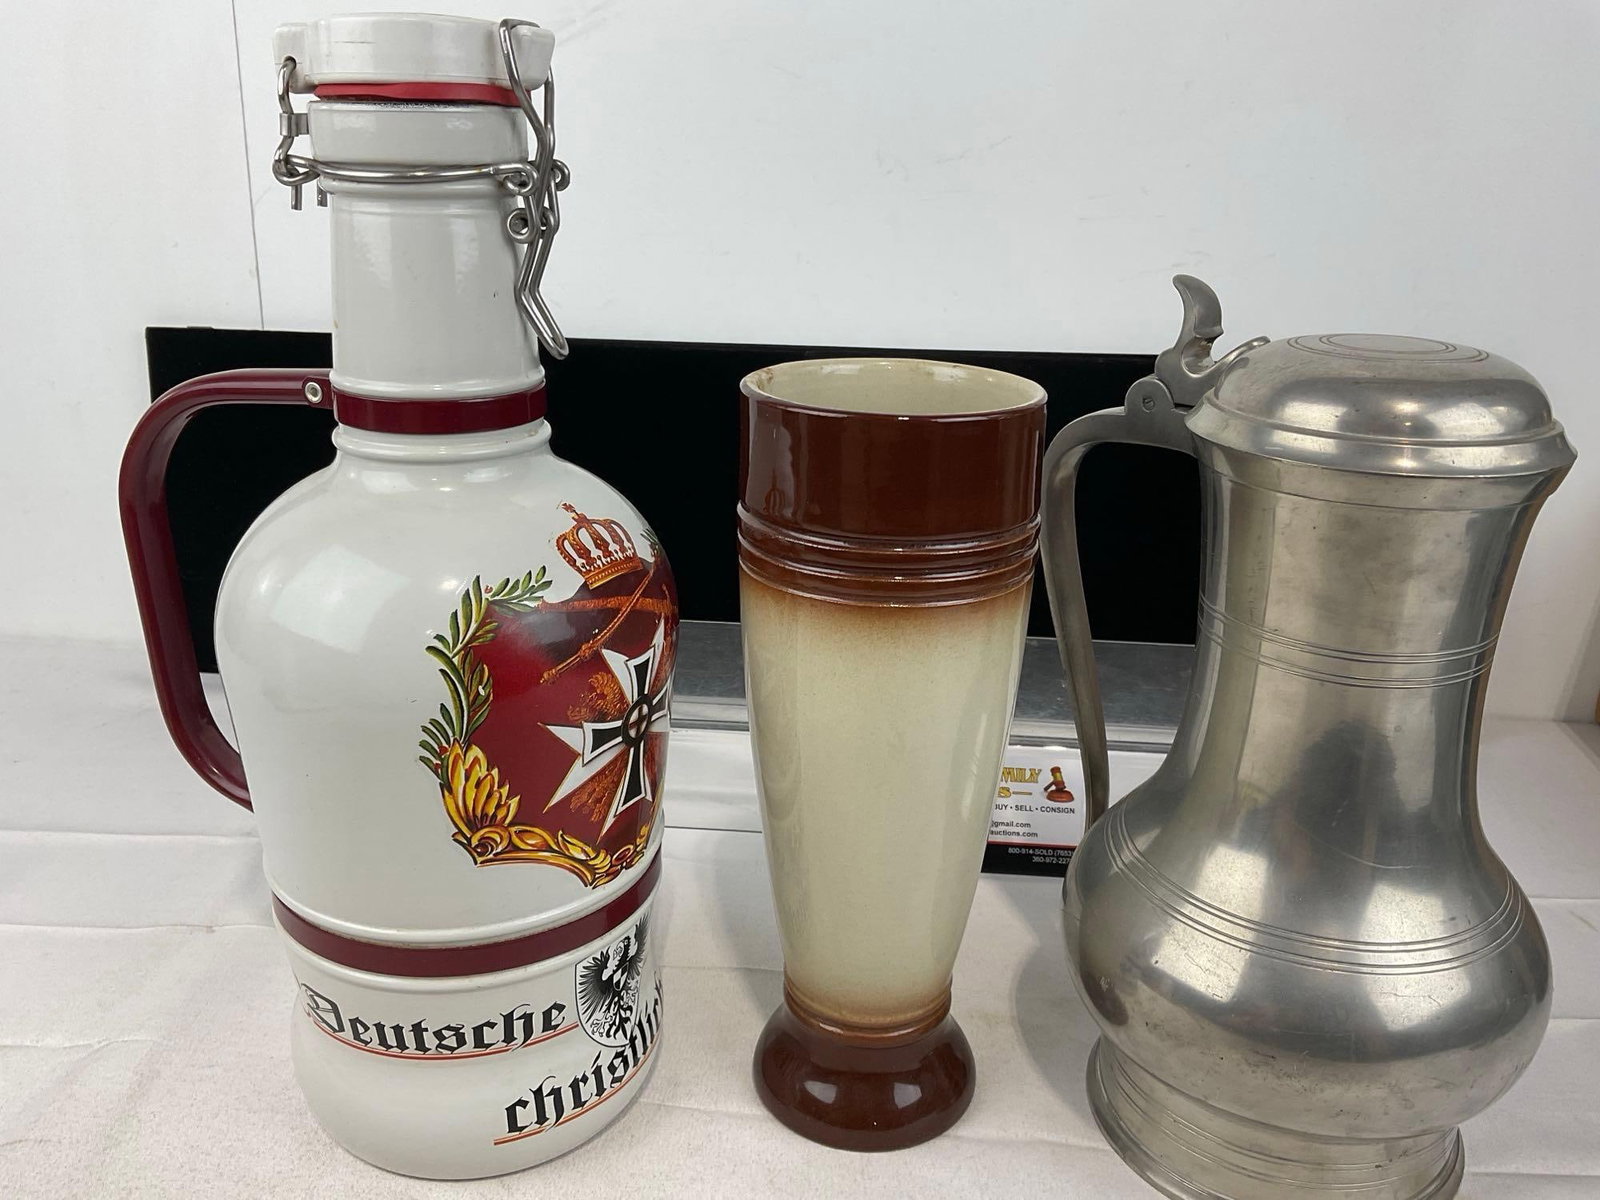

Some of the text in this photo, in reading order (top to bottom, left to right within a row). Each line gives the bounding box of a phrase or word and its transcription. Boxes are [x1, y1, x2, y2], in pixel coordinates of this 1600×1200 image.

[1014, 805, 1033, 813] SELL
[1040, 806, 1075, 814] CONSIGN
[299, 981, 567, 1054] Deutsche
